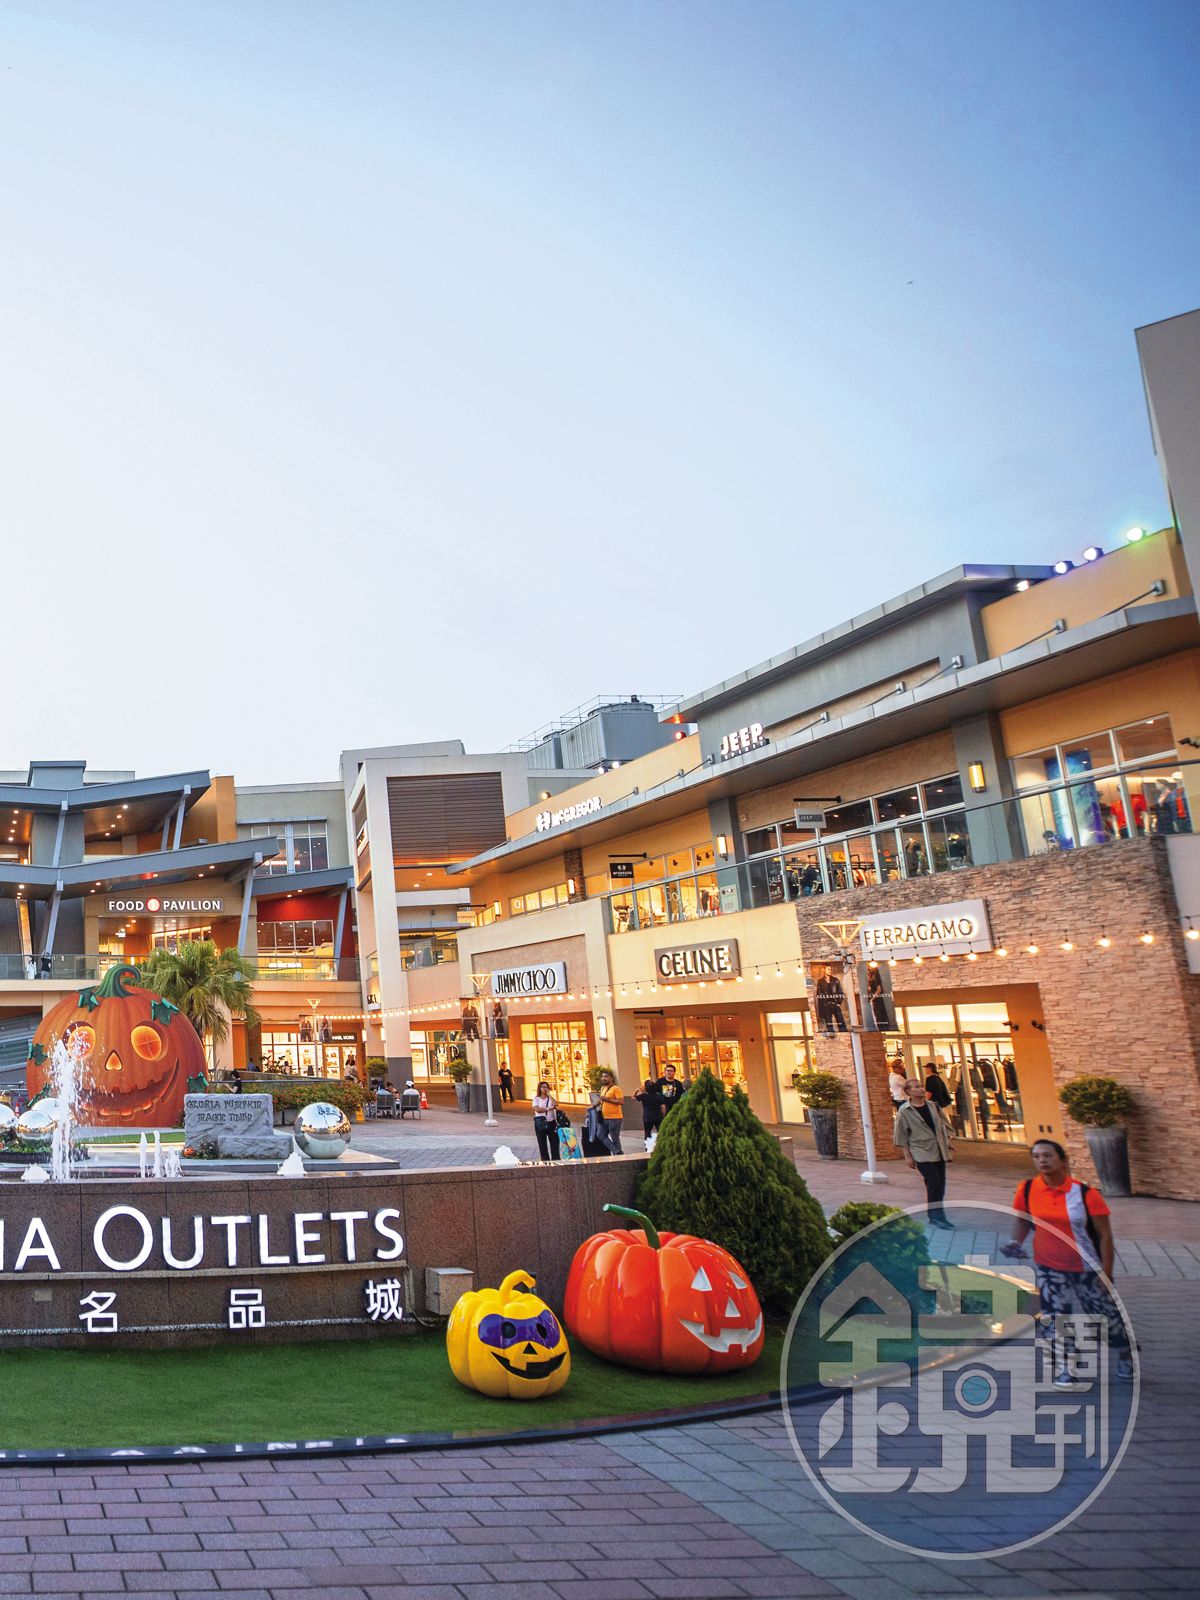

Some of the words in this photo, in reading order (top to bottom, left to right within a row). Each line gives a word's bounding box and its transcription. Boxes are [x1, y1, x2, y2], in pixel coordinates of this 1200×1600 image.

[721, 722, 764, 755] JEEP
[108, 900, 144, 911] FOOD
[163, 900, 221, 910] PAVILION
[863, 918, 974, 947] FERRAGAMO
[659, 947, 728, 977] CELINE
[495, 972, 521, 995] JIMMY
[521, 968, 556, 991] CHOO
[186, 1099, 220, 1109] GLORIA
[93, 1205, 404, 1271] OUTLETS
